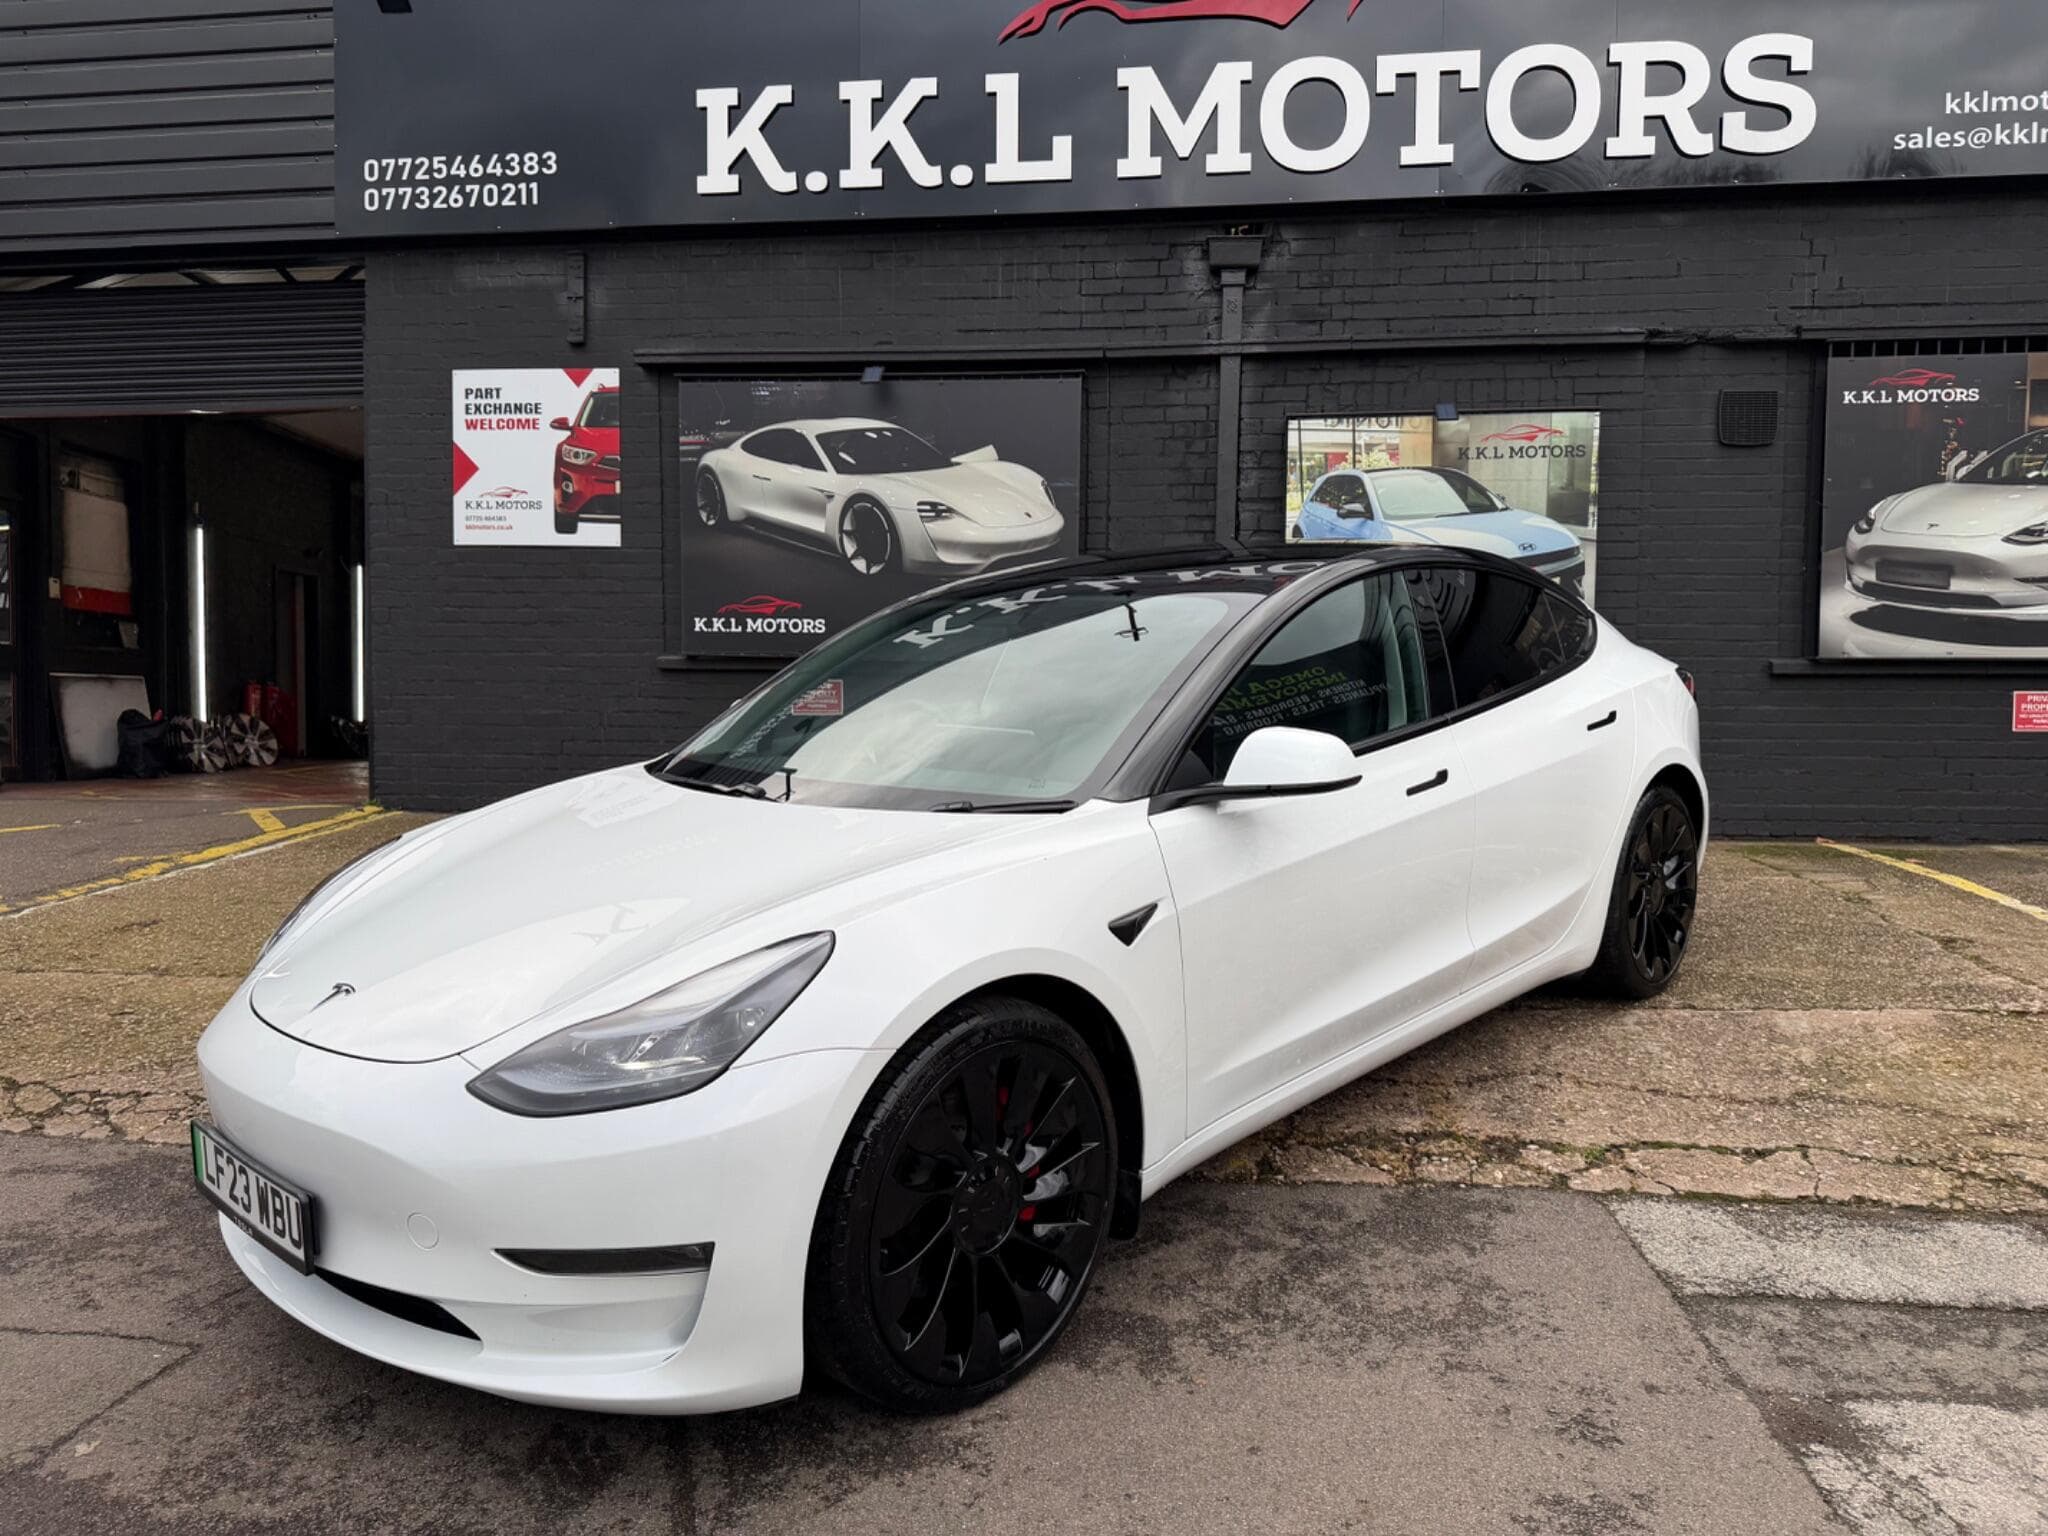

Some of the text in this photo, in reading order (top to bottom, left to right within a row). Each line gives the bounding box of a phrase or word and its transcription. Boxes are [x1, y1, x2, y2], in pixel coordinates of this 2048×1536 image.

[696, 33, 1818, 195] K.K.L MOTORS
[364, 151, 557, 182] 07725464383
[364, 182, 538, 211] 07732670211
[465, 388, 502, 400] PART
[1842, 388, 1980, 404] K.K.L MOTORS
[465, 402, 542, 415] EXCHANGE
[465, 418, 540, 431] WELCOME
[1458, 444, 1586, 460] K.K.L MOTORS
[496, 500, 543, 510] MOTORS
[694, 617, 826, 634] K.K.L MOTORS
[202, 1135, 302, 1250] LF23 WBU
